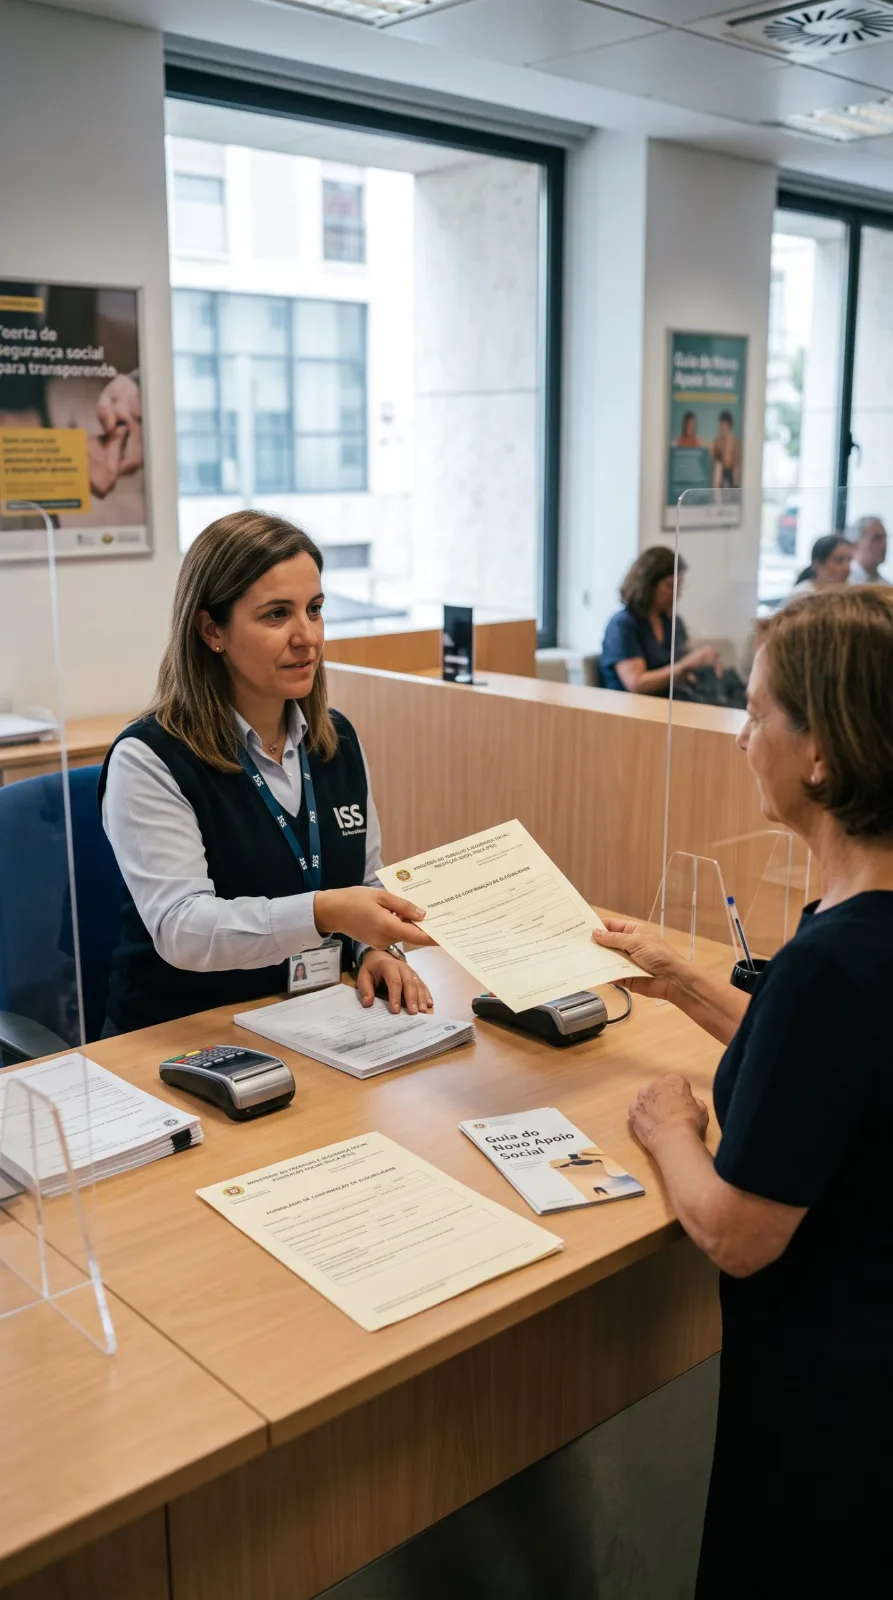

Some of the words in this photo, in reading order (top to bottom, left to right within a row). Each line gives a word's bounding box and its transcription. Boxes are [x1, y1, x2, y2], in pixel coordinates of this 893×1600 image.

[66, 345, 104, 360] social
[333, 804, 364, 829] ISS
[485, 1134, 518, 1143] Guia
[522, 1130, 540, 1138] do
[492, 1141, 530, 1152] Novo
[535, 1133, 575, 1145] Apoio
[500, 1147, 545, 1160] Social
